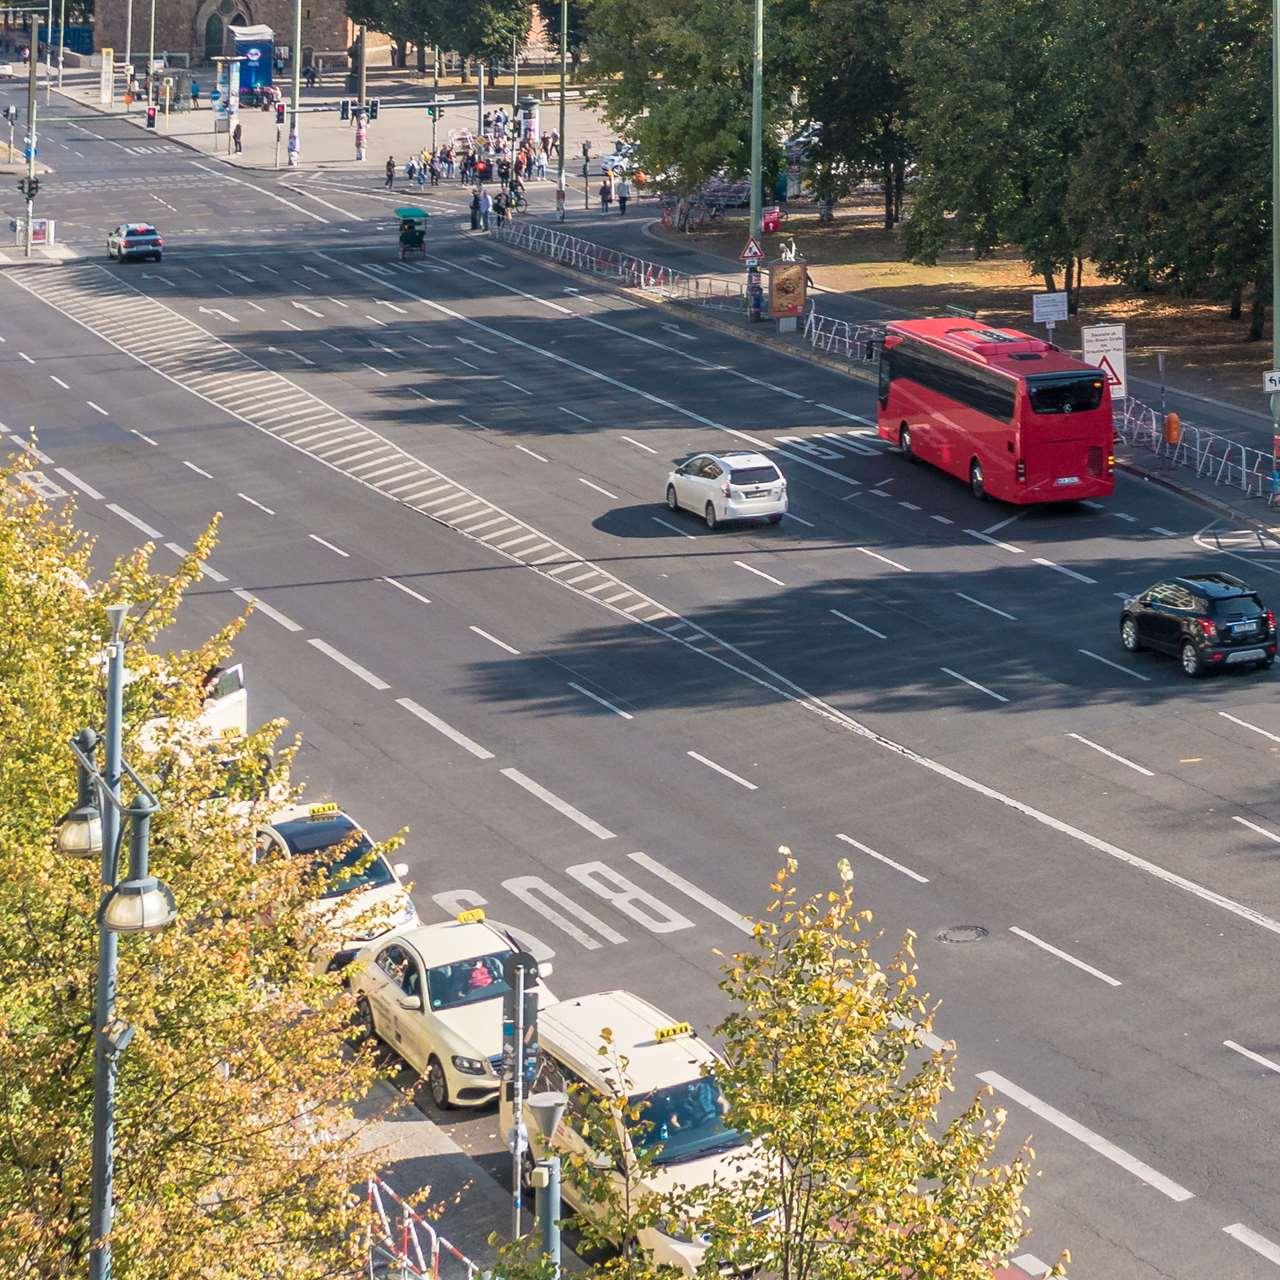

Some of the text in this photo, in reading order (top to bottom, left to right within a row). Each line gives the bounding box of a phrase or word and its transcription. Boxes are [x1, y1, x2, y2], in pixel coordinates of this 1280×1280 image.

[132, 145, 184, 154] BUS
[360, 262, 450, 276] BUS
[431, 860, 697, 960] BUS
